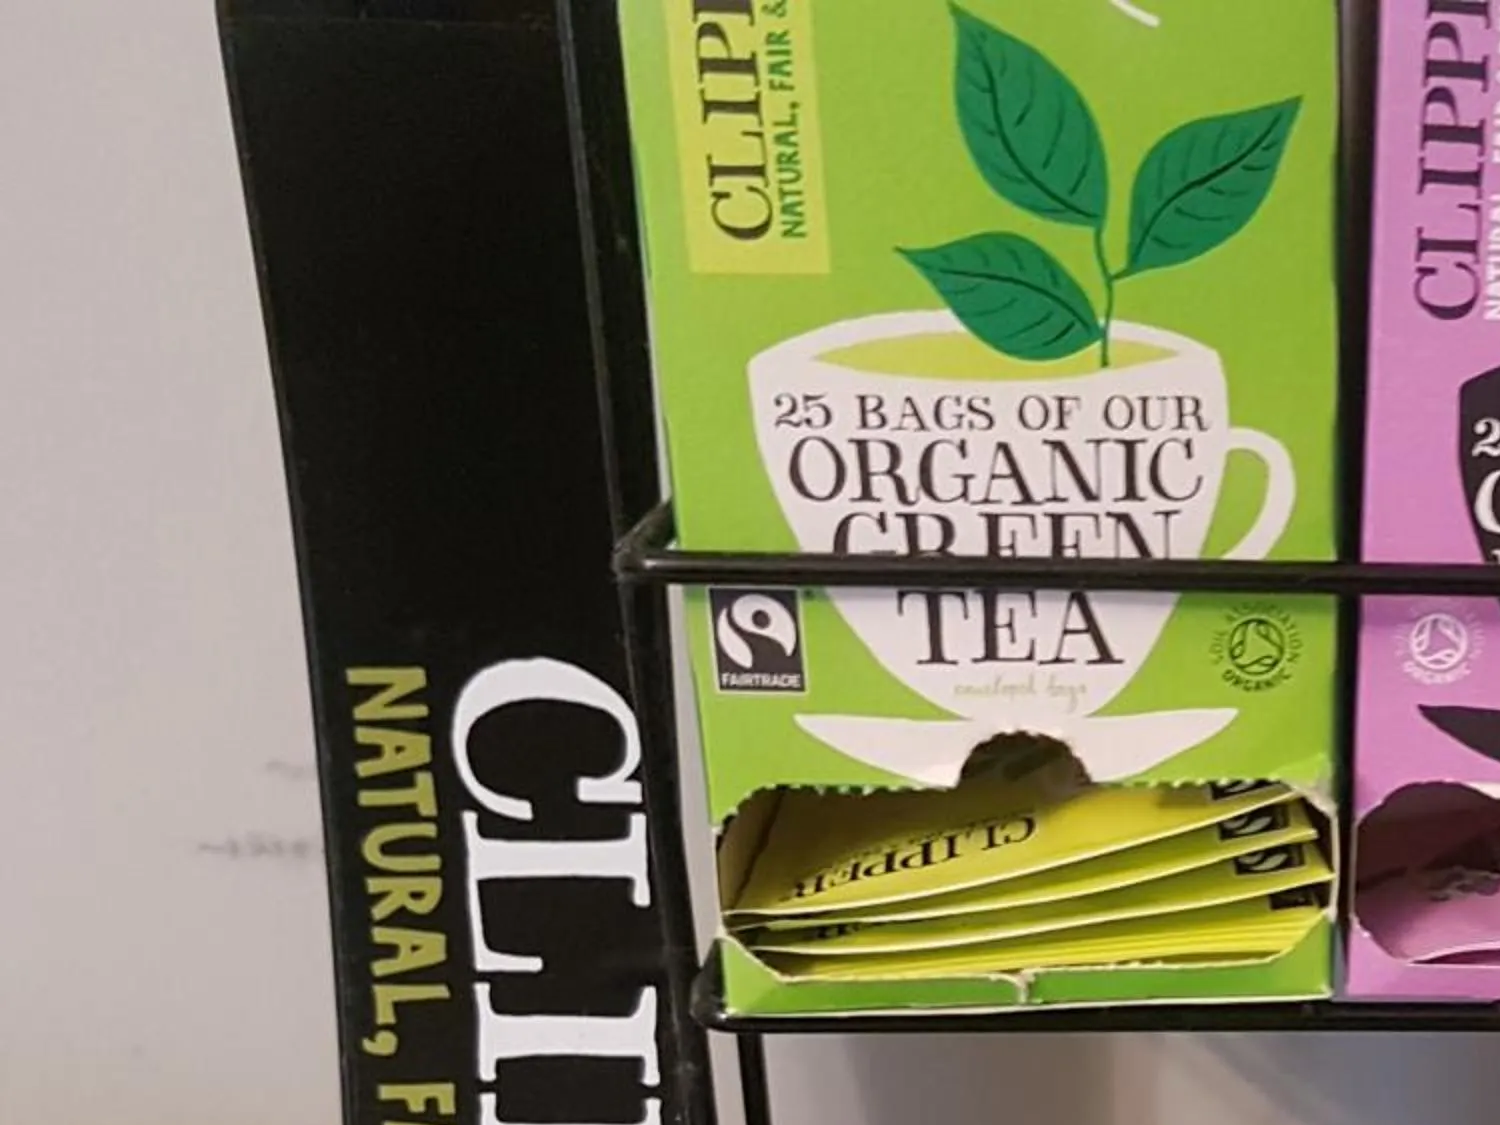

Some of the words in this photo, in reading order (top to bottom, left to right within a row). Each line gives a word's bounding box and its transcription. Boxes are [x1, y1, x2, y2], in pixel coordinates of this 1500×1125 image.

[765, 29, 795, 91] FAIR
[772, 101, 807, 238] NATURAL,
[774, 393, 833, 428] 25
[857, 395, 994, 430] BAGS
[1018, 396, 1081, 430] OF
[1103, 396, 1211, 432] OUR
[788, 435, 1204, 506] ORGANIC
[898, 589, 1124, 666] TEA
[345, 666, 451, 1056] NATURAL,
